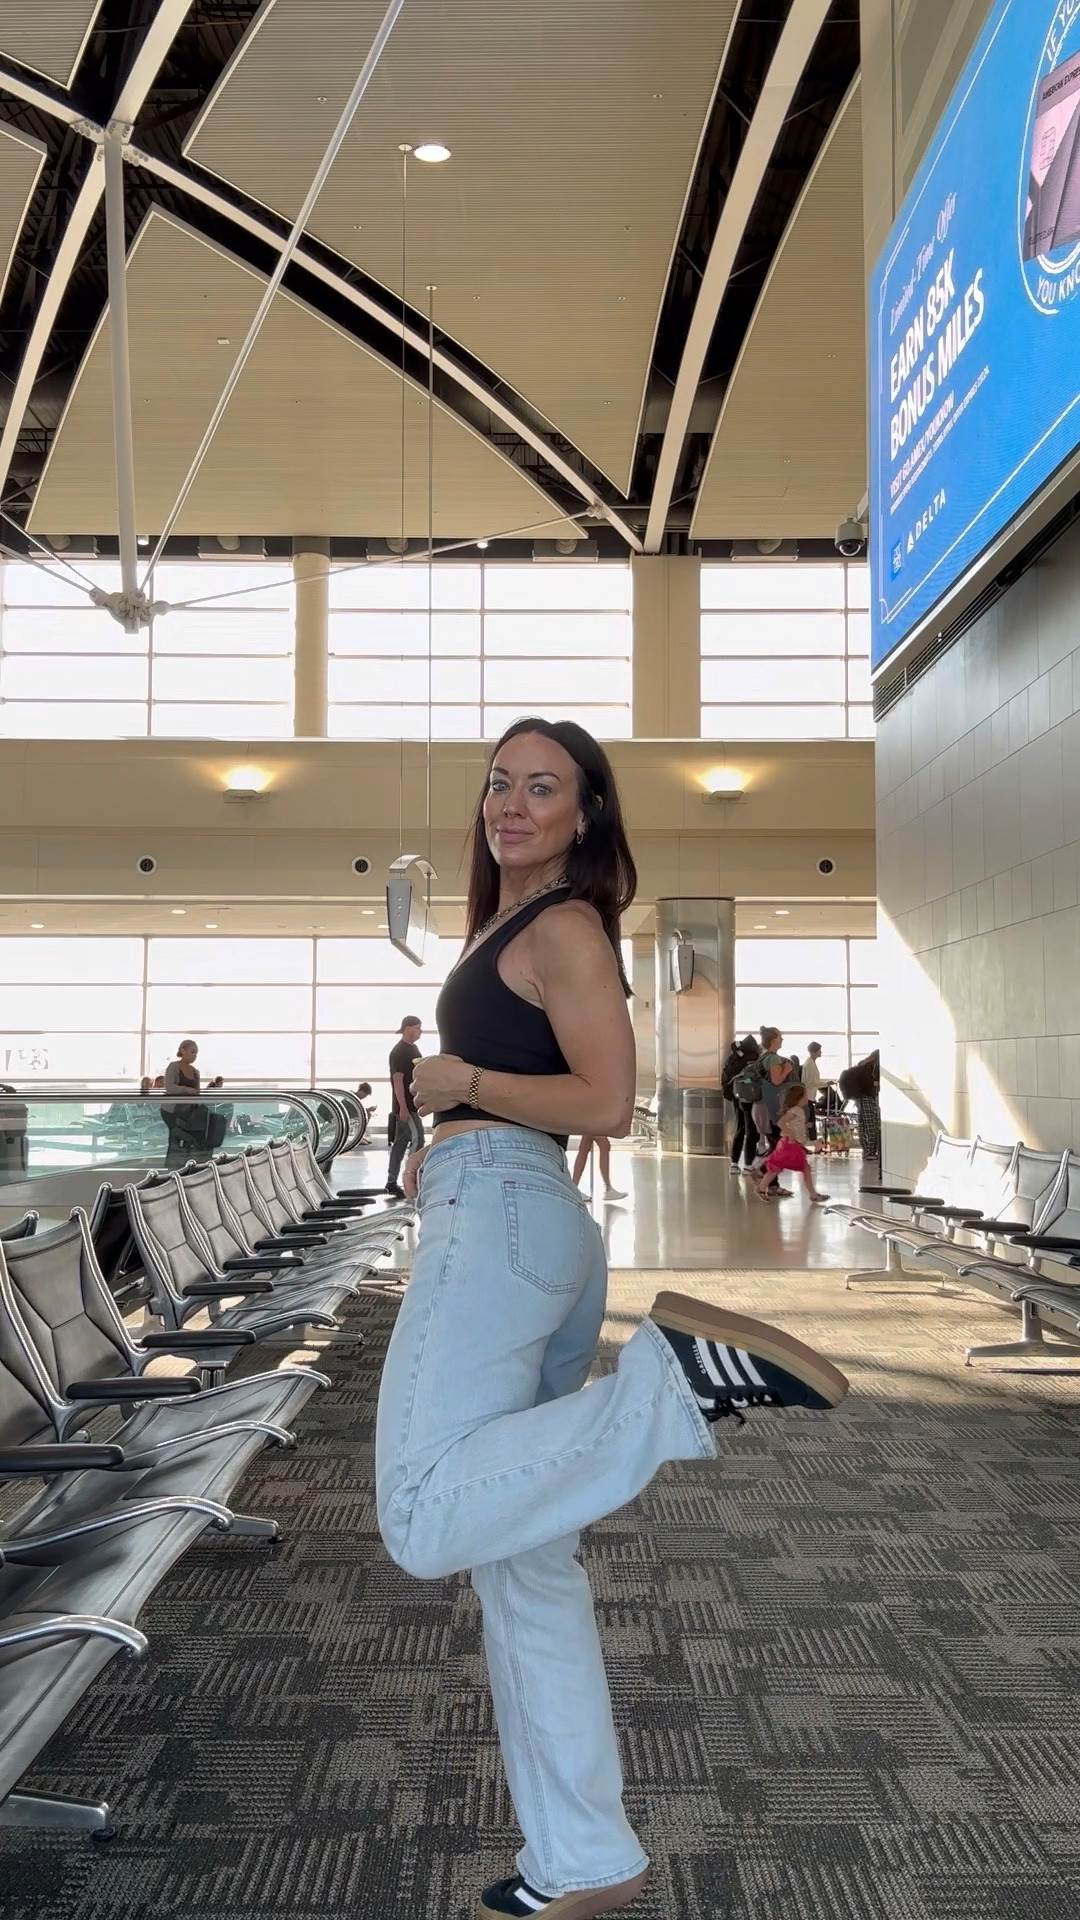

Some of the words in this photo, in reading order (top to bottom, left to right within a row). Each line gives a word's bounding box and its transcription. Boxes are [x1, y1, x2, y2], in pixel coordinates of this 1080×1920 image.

[1058, 0, 1080, 27] YO
[1037, 274, 1058, 305] YOU
[1059, 260, 1080, 302] KNO
[890, 305, 924, 404] EARN
[926, 247, 955, 337] 85K
[890, 351, 935, 462] BONUS
[937, 267, 984, 387] MILES
[915, 488, 946, 541] DELTA
